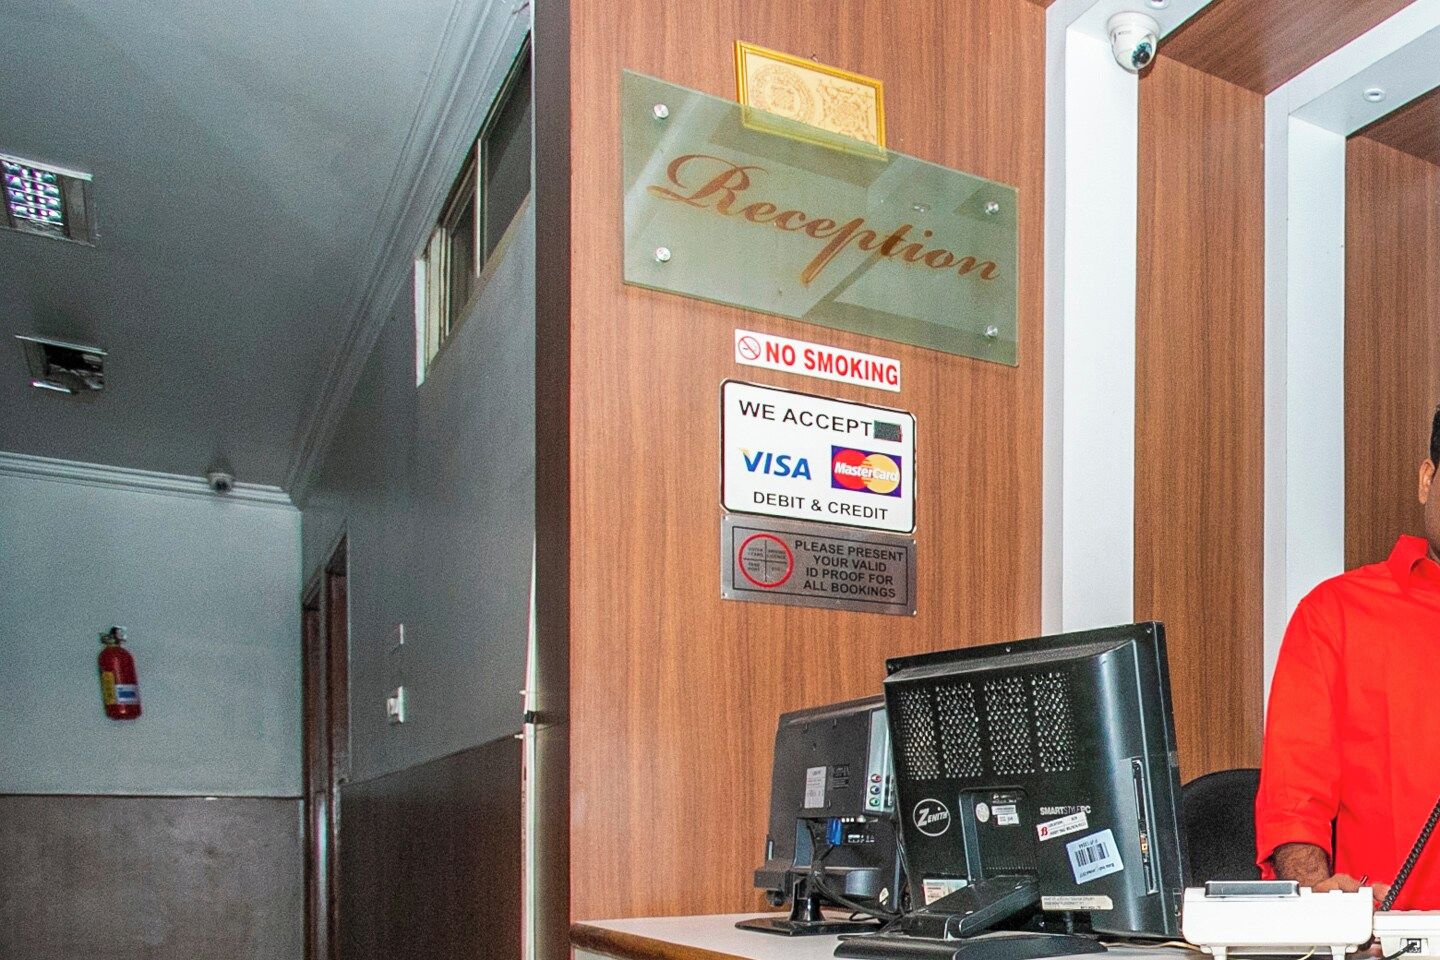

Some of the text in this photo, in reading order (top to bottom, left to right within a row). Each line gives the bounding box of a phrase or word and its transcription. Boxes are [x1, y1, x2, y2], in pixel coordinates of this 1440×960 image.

[646, 154, 1000, 286] Reception
[765, 340, 899, 386] NO SMOKING
[738, 399, 873, 437] WE ACCEPT
[739, 448, 812, 481] VISA
[834, 461, 900, 483] MasterCard
[753, 491, 888, 521] DEBIT & CREDIT
[795, 539, 845, 556] PLEASE
[848, 545, 904, 562] PRESENT
[813, 554, 887, 573] YOUR VALID
[803, 580, 897, 599] ALL BOOKINGS
[806, 567, 894, 587] ID PROOF FOR
